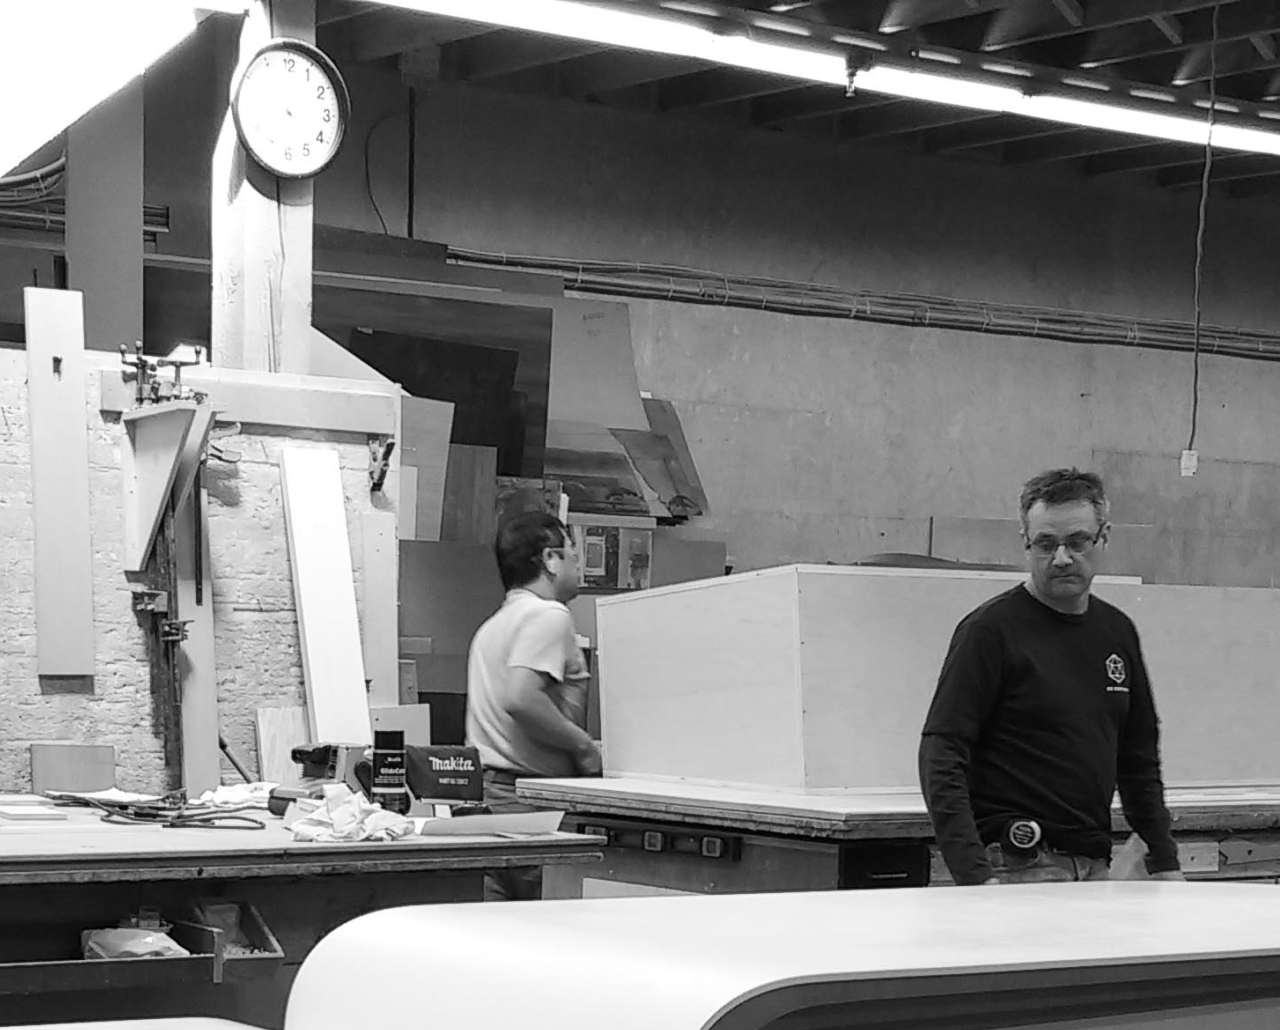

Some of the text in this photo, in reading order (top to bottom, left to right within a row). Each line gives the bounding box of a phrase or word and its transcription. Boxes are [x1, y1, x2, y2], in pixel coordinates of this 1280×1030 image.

[283, 58, 296, 73] 12
[305, 68, 310, 82] 1
[317, 85, 325, 100] 2
[323, 109, 331, 123] 3
[316, 131, 324, 144] 4
[284, 147, 292, 161] 6
[302, 143, 310, 157] 5
